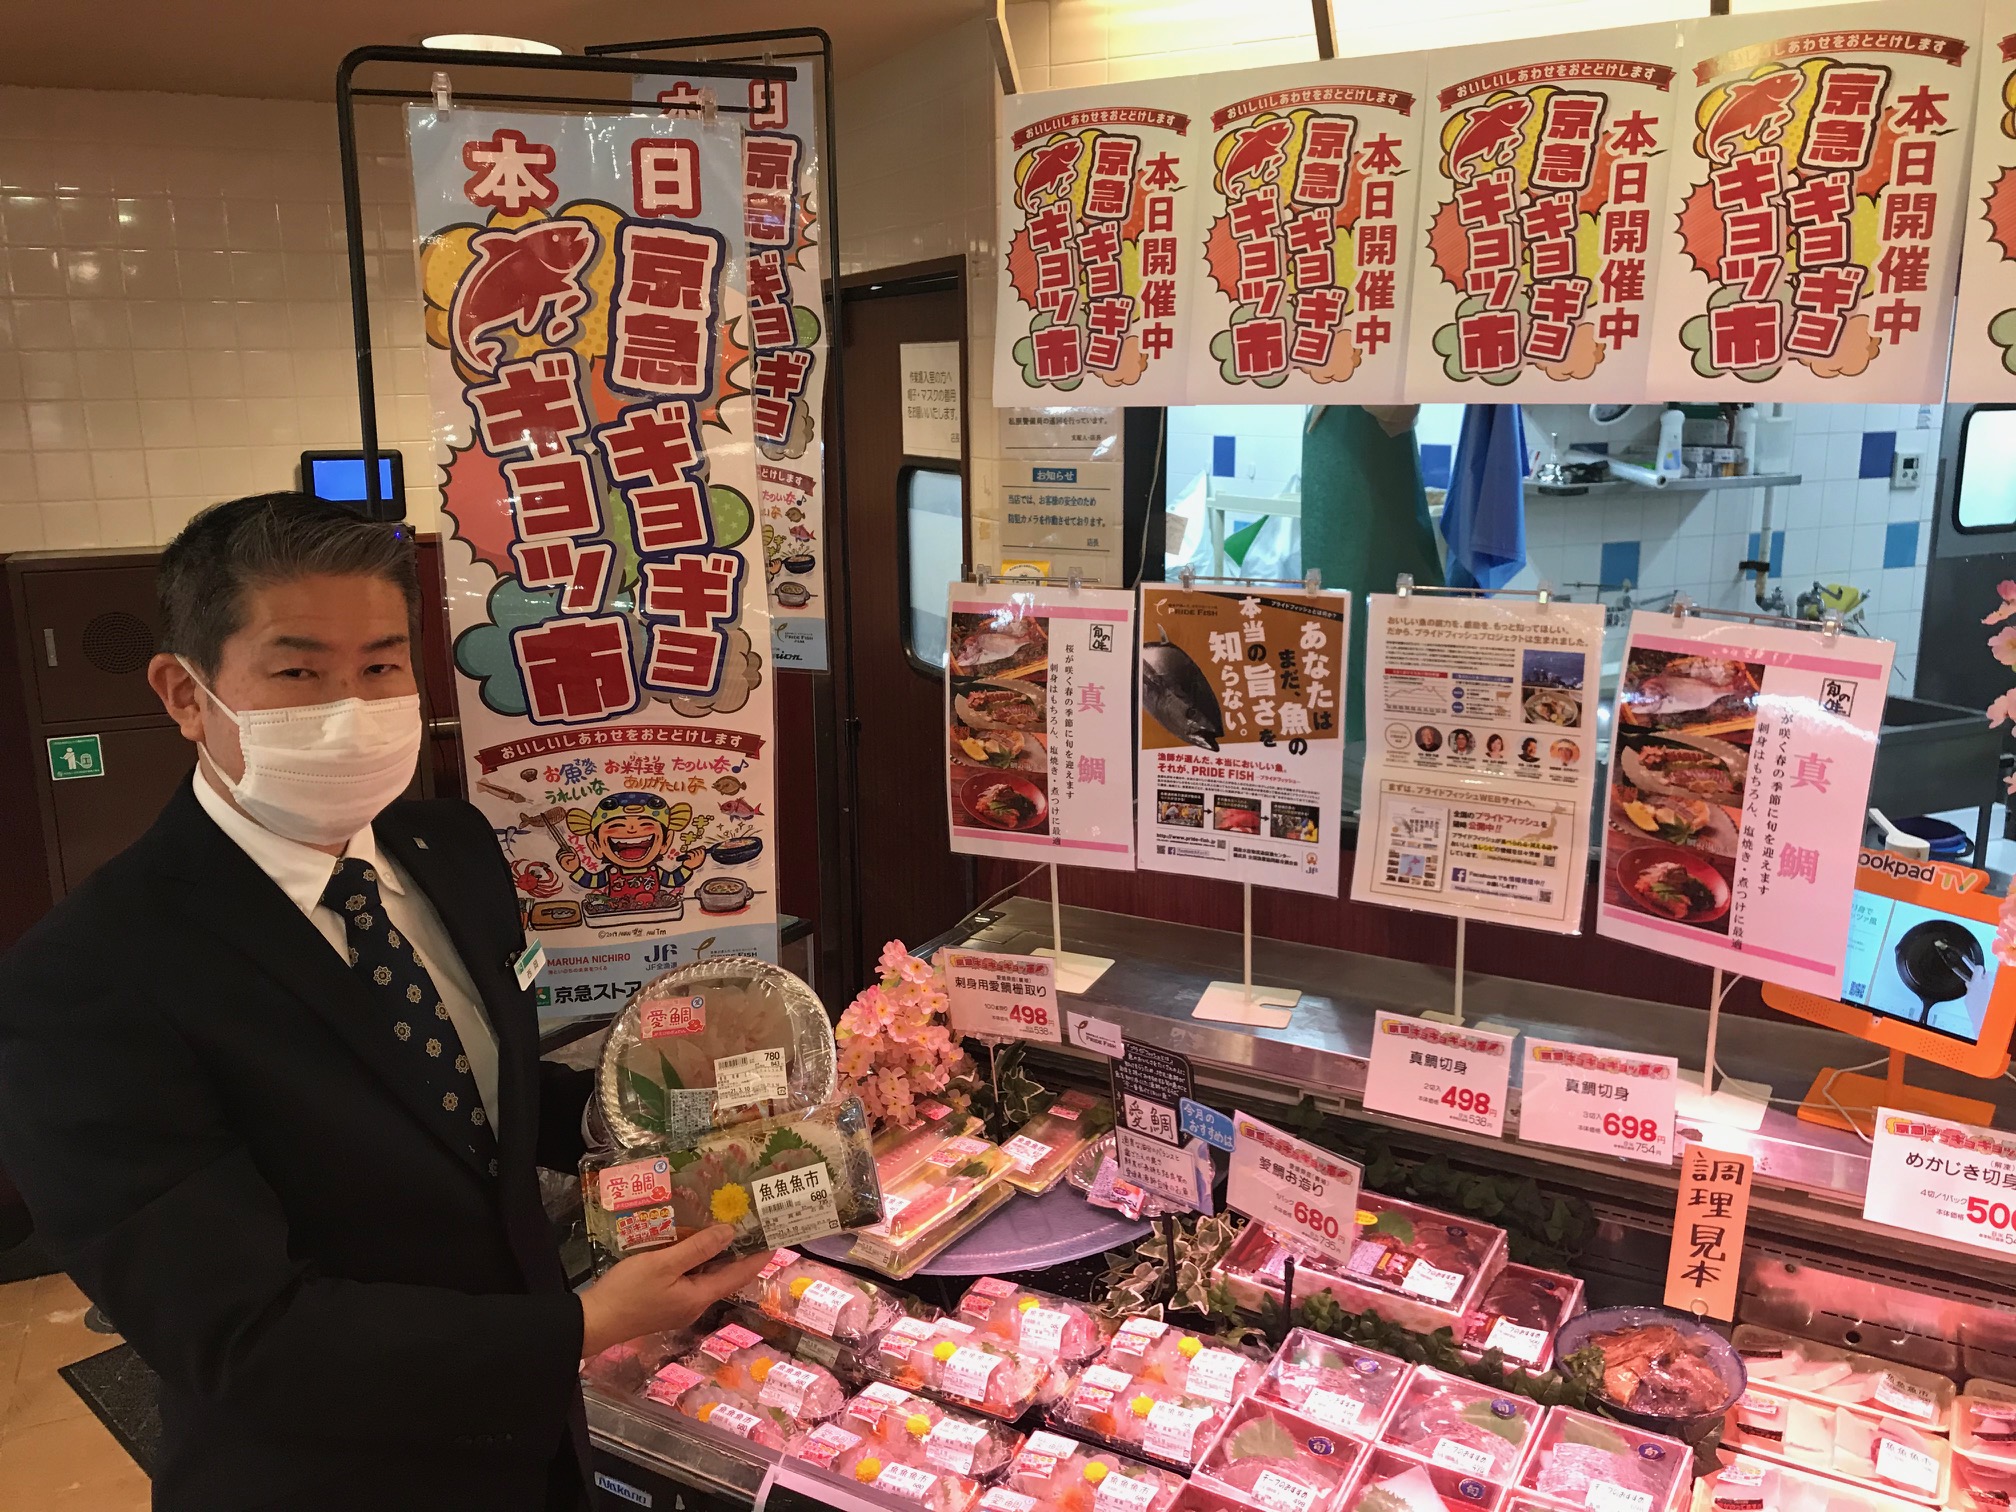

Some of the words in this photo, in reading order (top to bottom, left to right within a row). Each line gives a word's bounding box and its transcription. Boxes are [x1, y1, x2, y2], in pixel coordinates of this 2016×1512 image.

[1456, 63, 1657, 97] おいしいしあわせをおとどけします
[1226, 87, 1399, 119] おいしいしあわせをおとどけします
[1025, 109, 1177, 140] おいしいしあわせをおとどけします
[1873, 85, 1950, 346] 本日開催中
[1354, 132, 1403, 355] 本日開催中
[1598, 109, 1661, 351] 本日開催中
[1141, 150, 1181, 360] 本日開催中
[757, 467, 803, 487] どけします
[1036, 471, 1075, 482] お知らせ
[1008, 495, 1097, 507] 当店では、お客様の安全のため
[1208, 631, 1248, 737] 知らない。
[1239, 596, 1278, 748] 本当の旨さを
[1299, 621, 1334, 730] あなたは
[1277, 649, 1312, 756] まだ、魚の
[1065, 643, 1075, 800] 桜が咲く春の季節に旬を迎えます
[1077, 682, 1106, 785] 真鯛
[501, 729, 743, 760] おいしいしあわせをおとどけします
[1049, 663, 1062, 846] 刺身はもちろん、塩焼き・煮つけに最適
[672, 756, 731, 773] たのしいな
[1157, 752, 1288, 773] 漁師が選んだ、本当においしい魚。
[1157, 763, 1190, 775] それが、
[1191, 766, 1225, 778] PRIDE
[1228, 769, 1255, 782] FISH
[545, 778, 610, 804] うれしいな
[623, 775, 707, 795] ありがたいな
[1757, 706, 1796, 897] が咲く春の季節に旬を迎えます
[1775, 752, 1835, 885] 真鯛
[1731, 722, 1770, 950] 刺身はもちろん、塩焼き・煮つけに最適
[1938, 865, 1979, 894] TV
[547, 957, 589, 967] MARUHA
[592, 952, 631, 965] NICHIRO
[554, 980, 642, 1004] 京急ストア
[955, 976, 1047, 998] 刺身用愛鯛柵取り
[647, 1007, 692, 1029] 愛鯛
[764, 1051, 780, 1061] 780
[1408, 1051, 1468, 1075] 真鯛切身
[1565, 1078, 1630, 1101] 真鯛切身
[1183, 1103, 1215, 1124] 今月の
[1189, 1121, 1233, 1147] おすすめは
[606, 1173, 655, 1200] 愛鯛
[758, 1170, 820, 1202] 魚魚魚市
[1259, 1156, 1324, 1197] 愛鯛お造り
[810, 1189, 828, 1202] 680
[1680, 1150, 1744, 1289] 調理見本
[1936, 1208, 1965, 1221] 本体価格
[736, 1423, 748, 1433] 680
[597, 1477, 648, 1504] Nakano
[912, 1482, 925, 1490] 680
